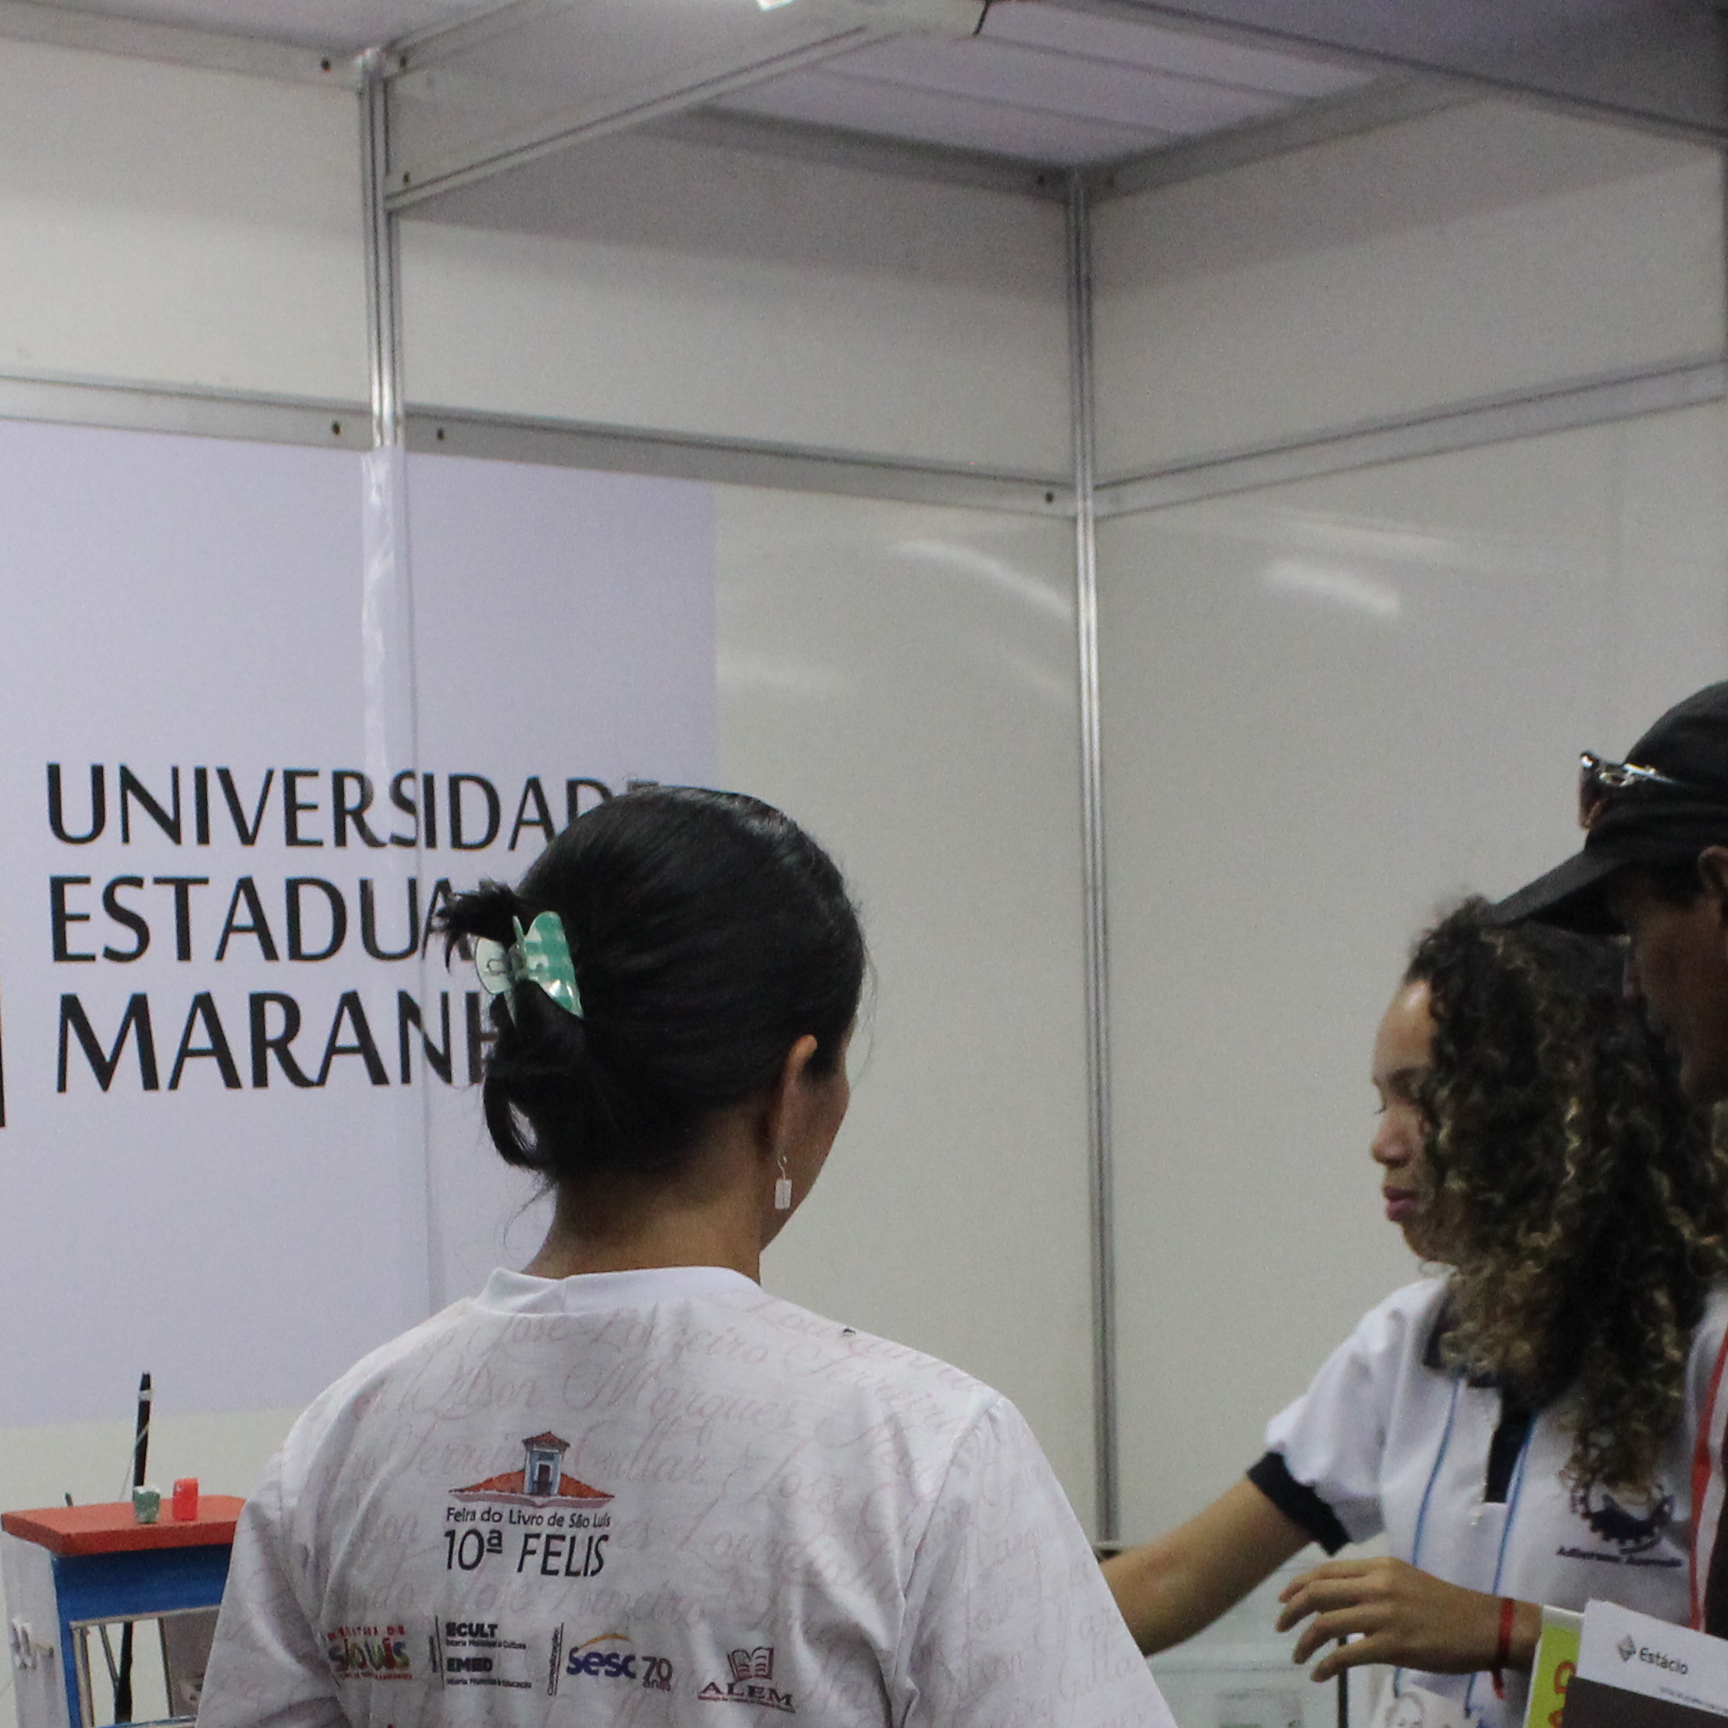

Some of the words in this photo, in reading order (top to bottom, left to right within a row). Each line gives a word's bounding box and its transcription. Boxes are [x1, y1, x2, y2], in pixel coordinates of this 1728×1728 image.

[46, 762, 660, 852] UNIVERSIDAD
[48, 875, 497, 963] ESTADUA
[55, 989, 500, 1093] MARANH
[480, 1507, 503, 1523] do
[508, 1509, 544, 1526] Livro
[547, 1512, 564, 1527] de
[516, 1532, 610, 1578] FELIS
[641, 1655, 672, 1682] 70
[1639, 1646, 1688, 1675] Estácio
